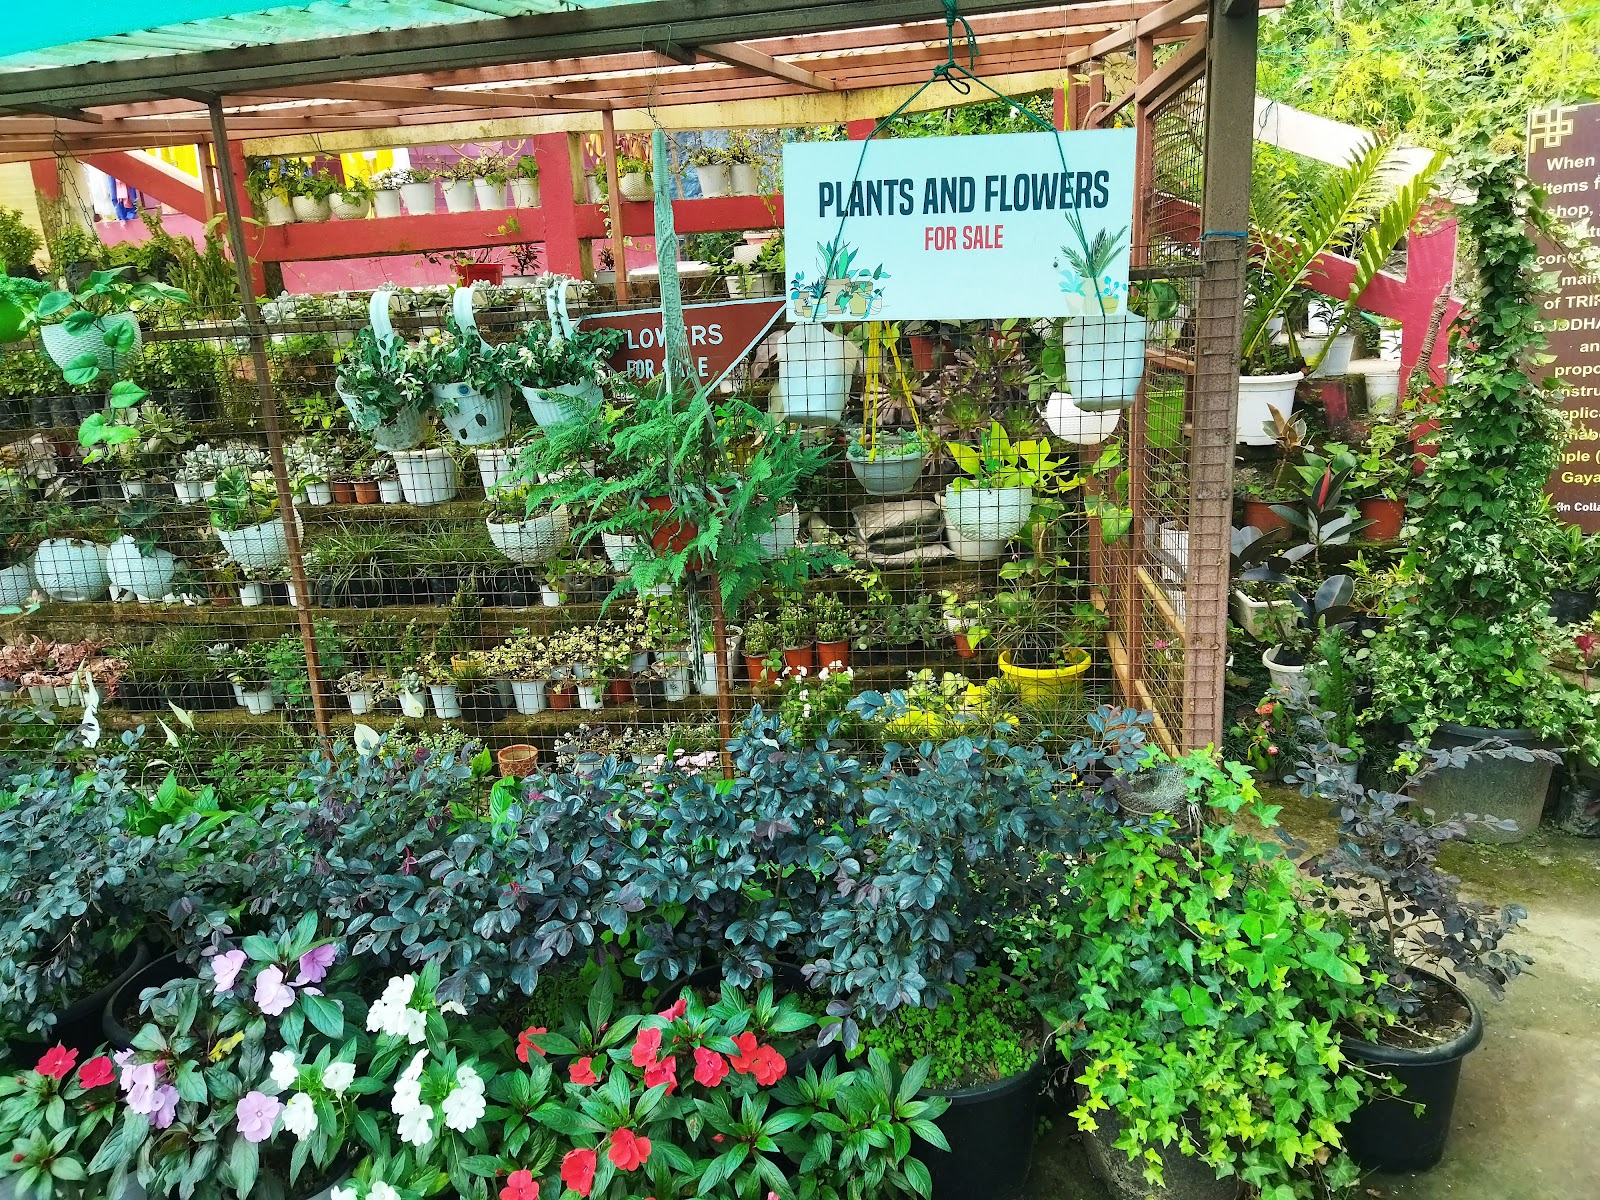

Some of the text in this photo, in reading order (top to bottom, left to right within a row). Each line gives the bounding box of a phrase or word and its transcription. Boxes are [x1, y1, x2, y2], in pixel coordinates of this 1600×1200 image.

[1546, 156, 1595, 171] When
[819, 170, 1110, 218] PLANTS AND FLOWERS
[1542, 180, 1589, 195] items
[925, 224, 1004, 250] FOR SALE
[1543, 296, 1561, 310] of
[626, 359, 655, 380] FOR
